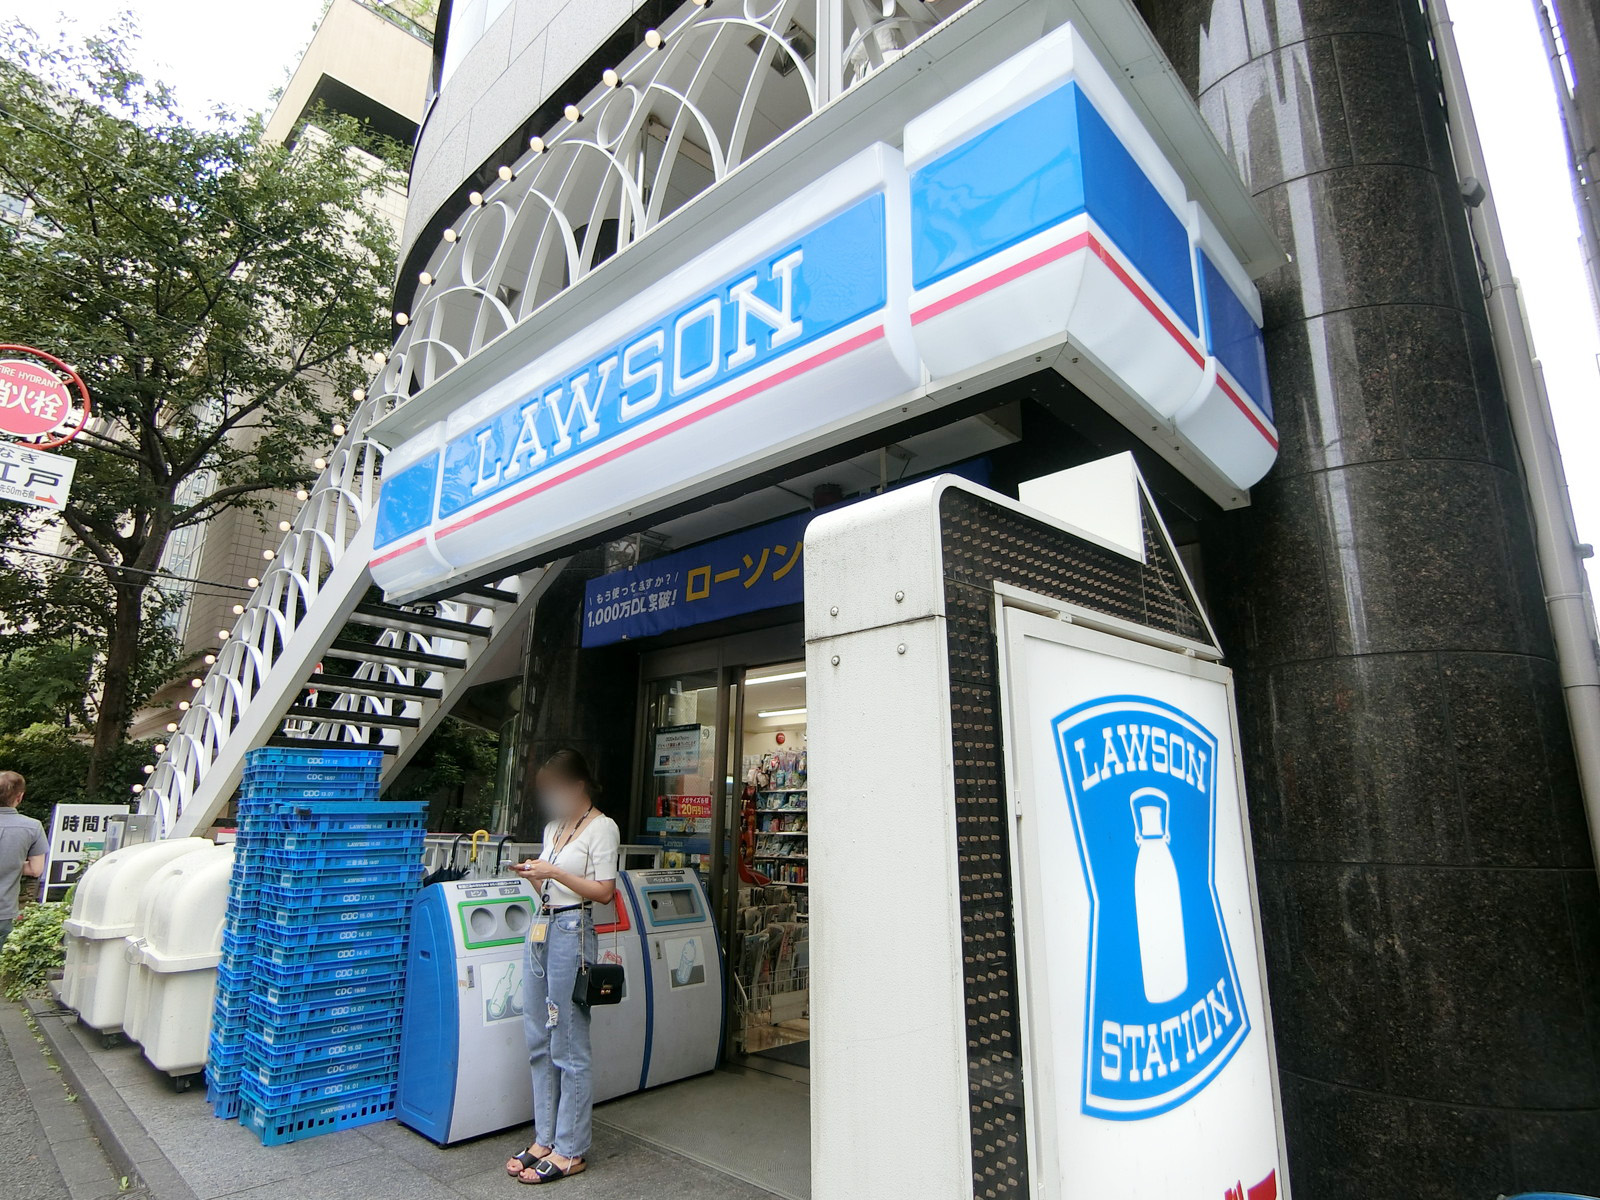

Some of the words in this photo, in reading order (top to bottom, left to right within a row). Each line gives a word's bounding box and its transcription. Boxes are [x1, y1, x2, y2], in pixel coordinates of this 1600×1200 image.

[471, 249, 804, 496] LAWSON
[18, 371, 59, 389] HYDRANT
[685, 541, 804, 602] ローソン
[1075, 724, 1207, 793] LAWSON
[303, 789, 320, 797] CDC
[61, 839, 81, 853] IN
[60, 862, 80, 881] P
[343, 894, 361, 902] CDC
[341, 912, 359, 921] CDC
[339, 930, 357, 940] CDC
[337, 949, 355, 959] CDC
[335, 968, 353, 978] CDC
[335, 987, 353, 996] CDC
[331, 1006, 350, 1016] CDC
[331, 1024, 349, 1034] CDC
[1101, 979, 1234, 1082] STATION
[328, 1044, 347, 1056] CDC
[326, 1064, 345, 1074] CDC
[324, 1084, 343, 1095] CDC
[320, 1104, 345, 1115] LAWSON
